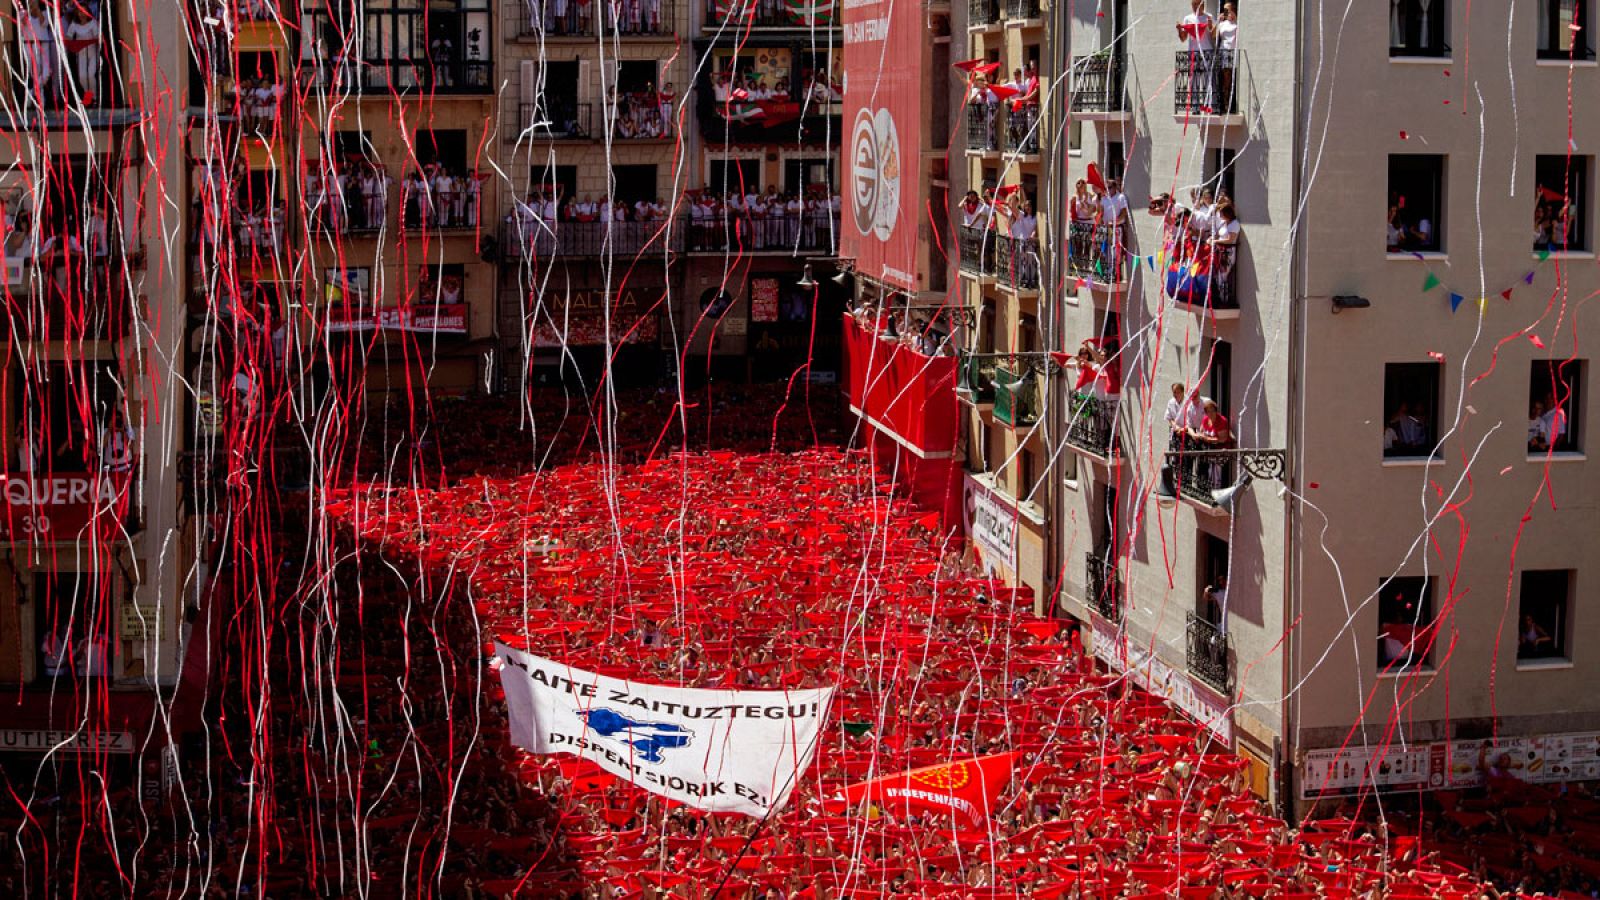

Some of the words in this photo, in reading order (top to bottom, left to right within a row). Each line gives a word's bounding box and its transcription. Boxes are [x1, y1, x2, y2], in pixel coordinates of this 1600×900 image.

[552, 291, 637, 309] MALTEA
[22, 515, 50, 533] 30
[609, 689, 818, 720] ZAITUZTEGU!
[735, 782, 768, 808] EZ!
